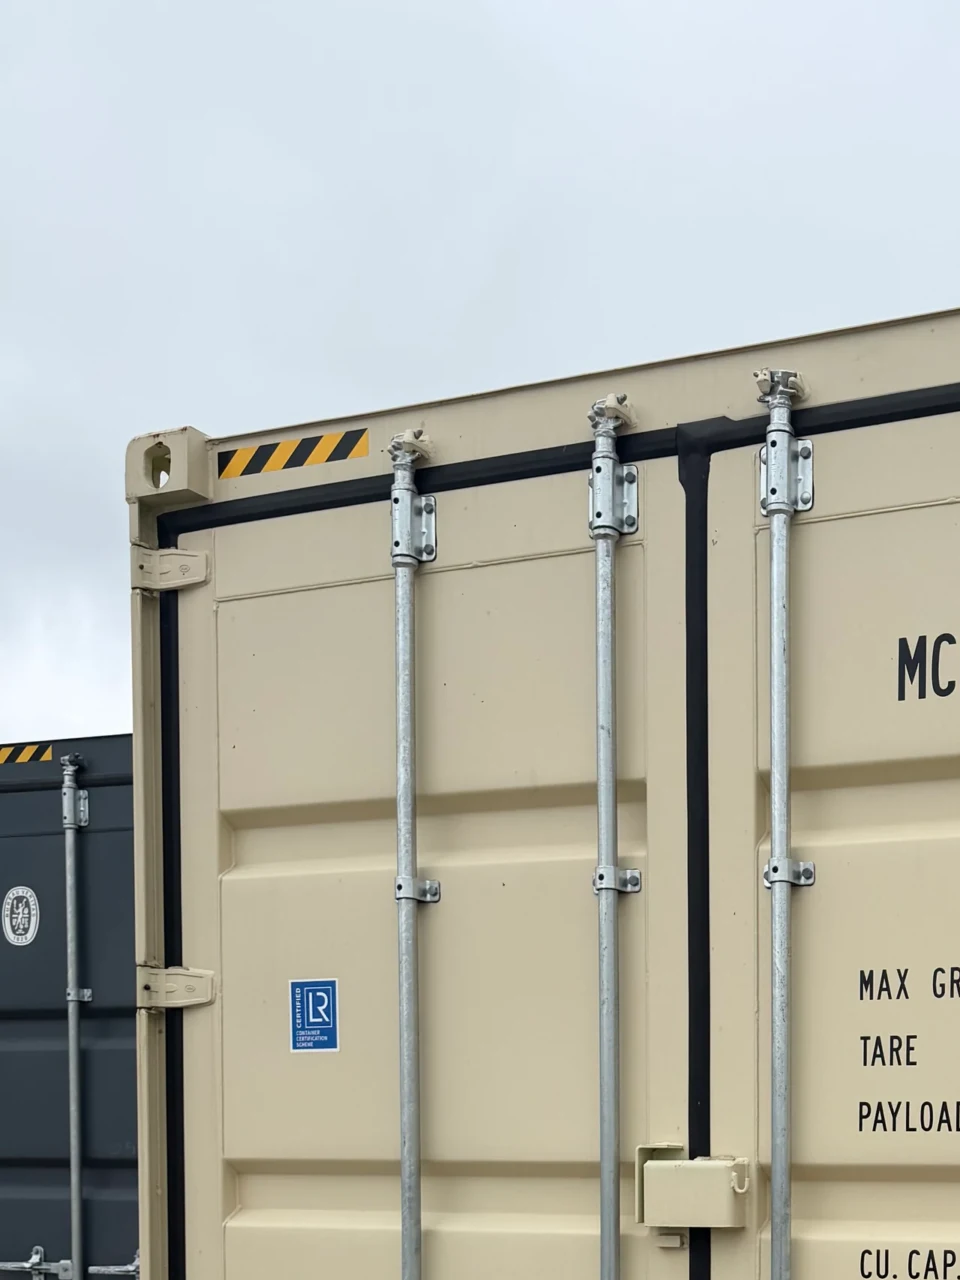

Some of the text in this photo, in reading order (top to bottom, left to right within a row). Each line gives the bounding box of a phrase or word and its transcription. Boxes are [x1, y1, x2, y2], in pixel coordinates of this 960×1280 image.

[859, 968, 910, 1001] MAX
[308, 991, 330, 1022] LR
[860, 1034, 918, 1067] TARE
[860, 1249, 898, 1280] CU.
